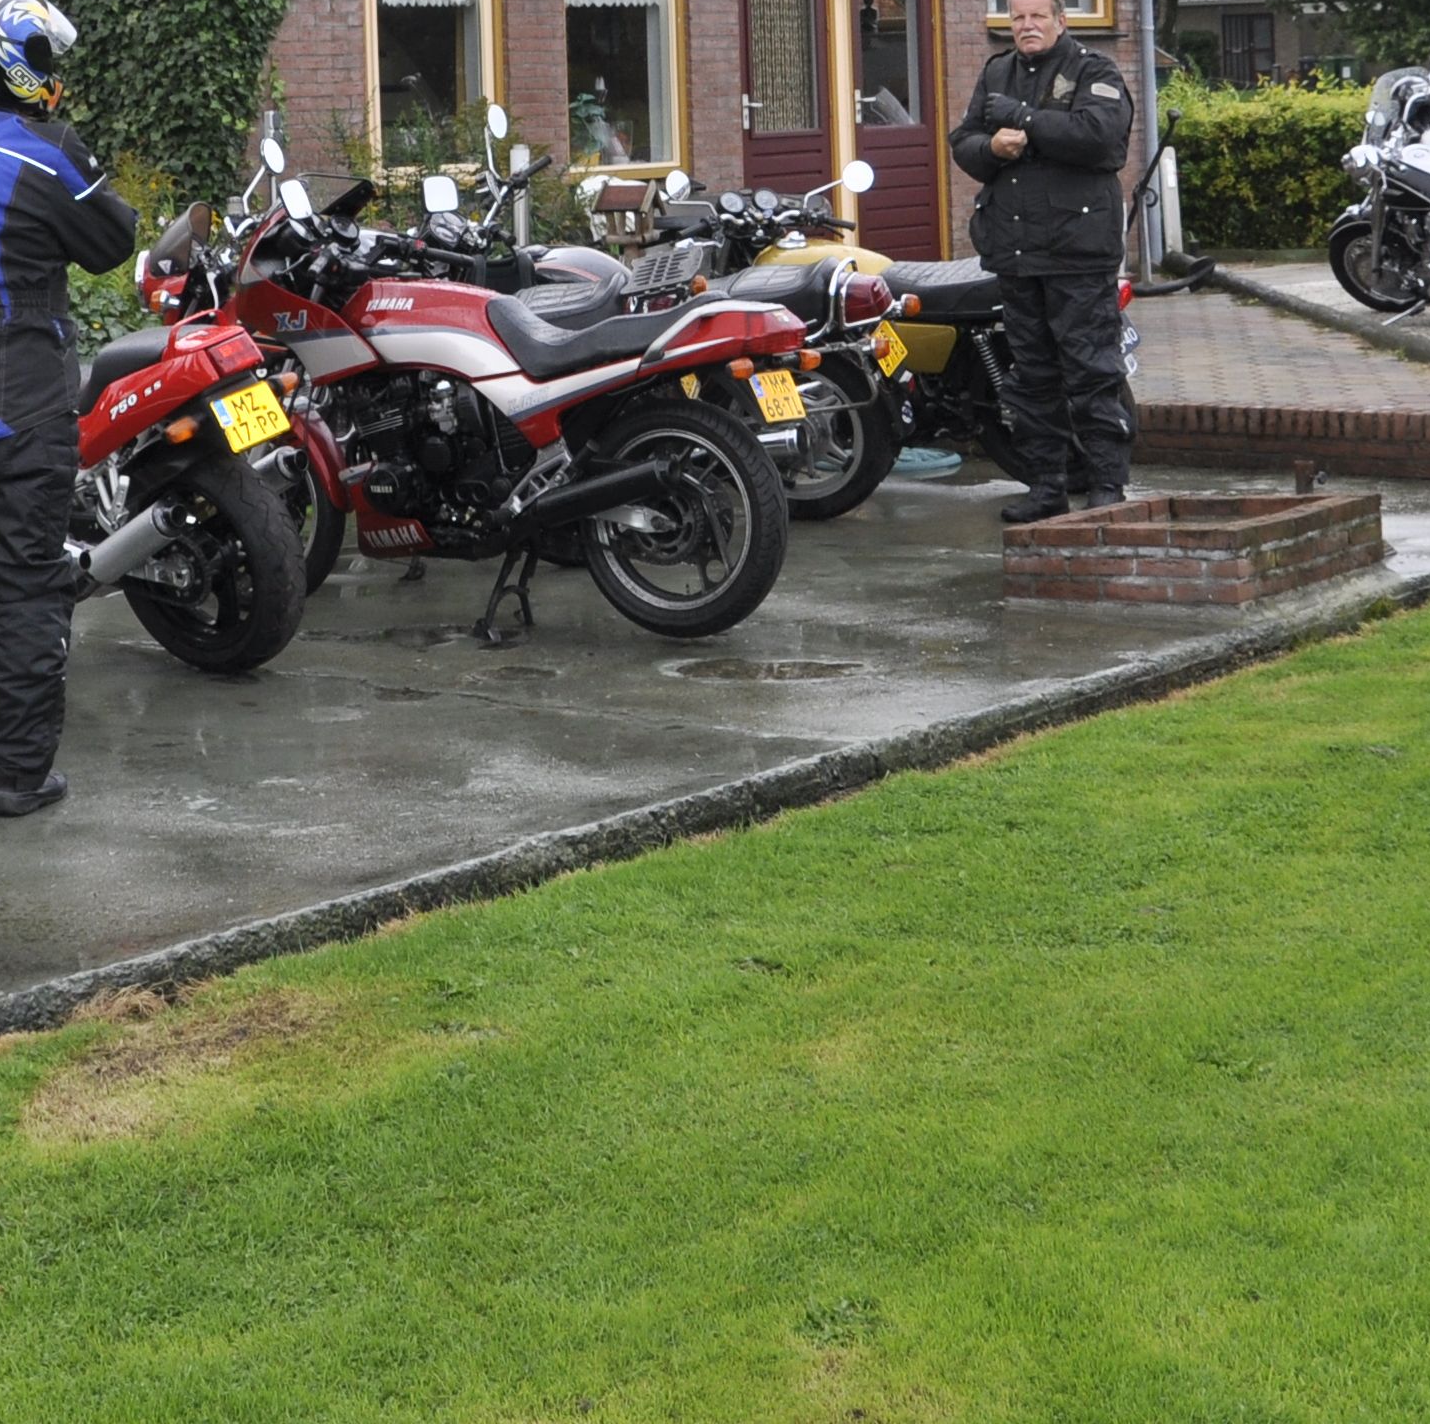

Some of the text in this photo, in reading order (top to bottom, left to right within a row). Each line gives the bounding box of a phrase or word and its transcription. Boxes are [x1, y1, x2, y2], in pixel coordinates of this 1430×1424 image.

[365, 297, 414, 312] YAMAHA
[272, 309, 308, 332] XJ
[109, 393, 138, 421] 750
[363, 524, 423, 547] YAMAHA
